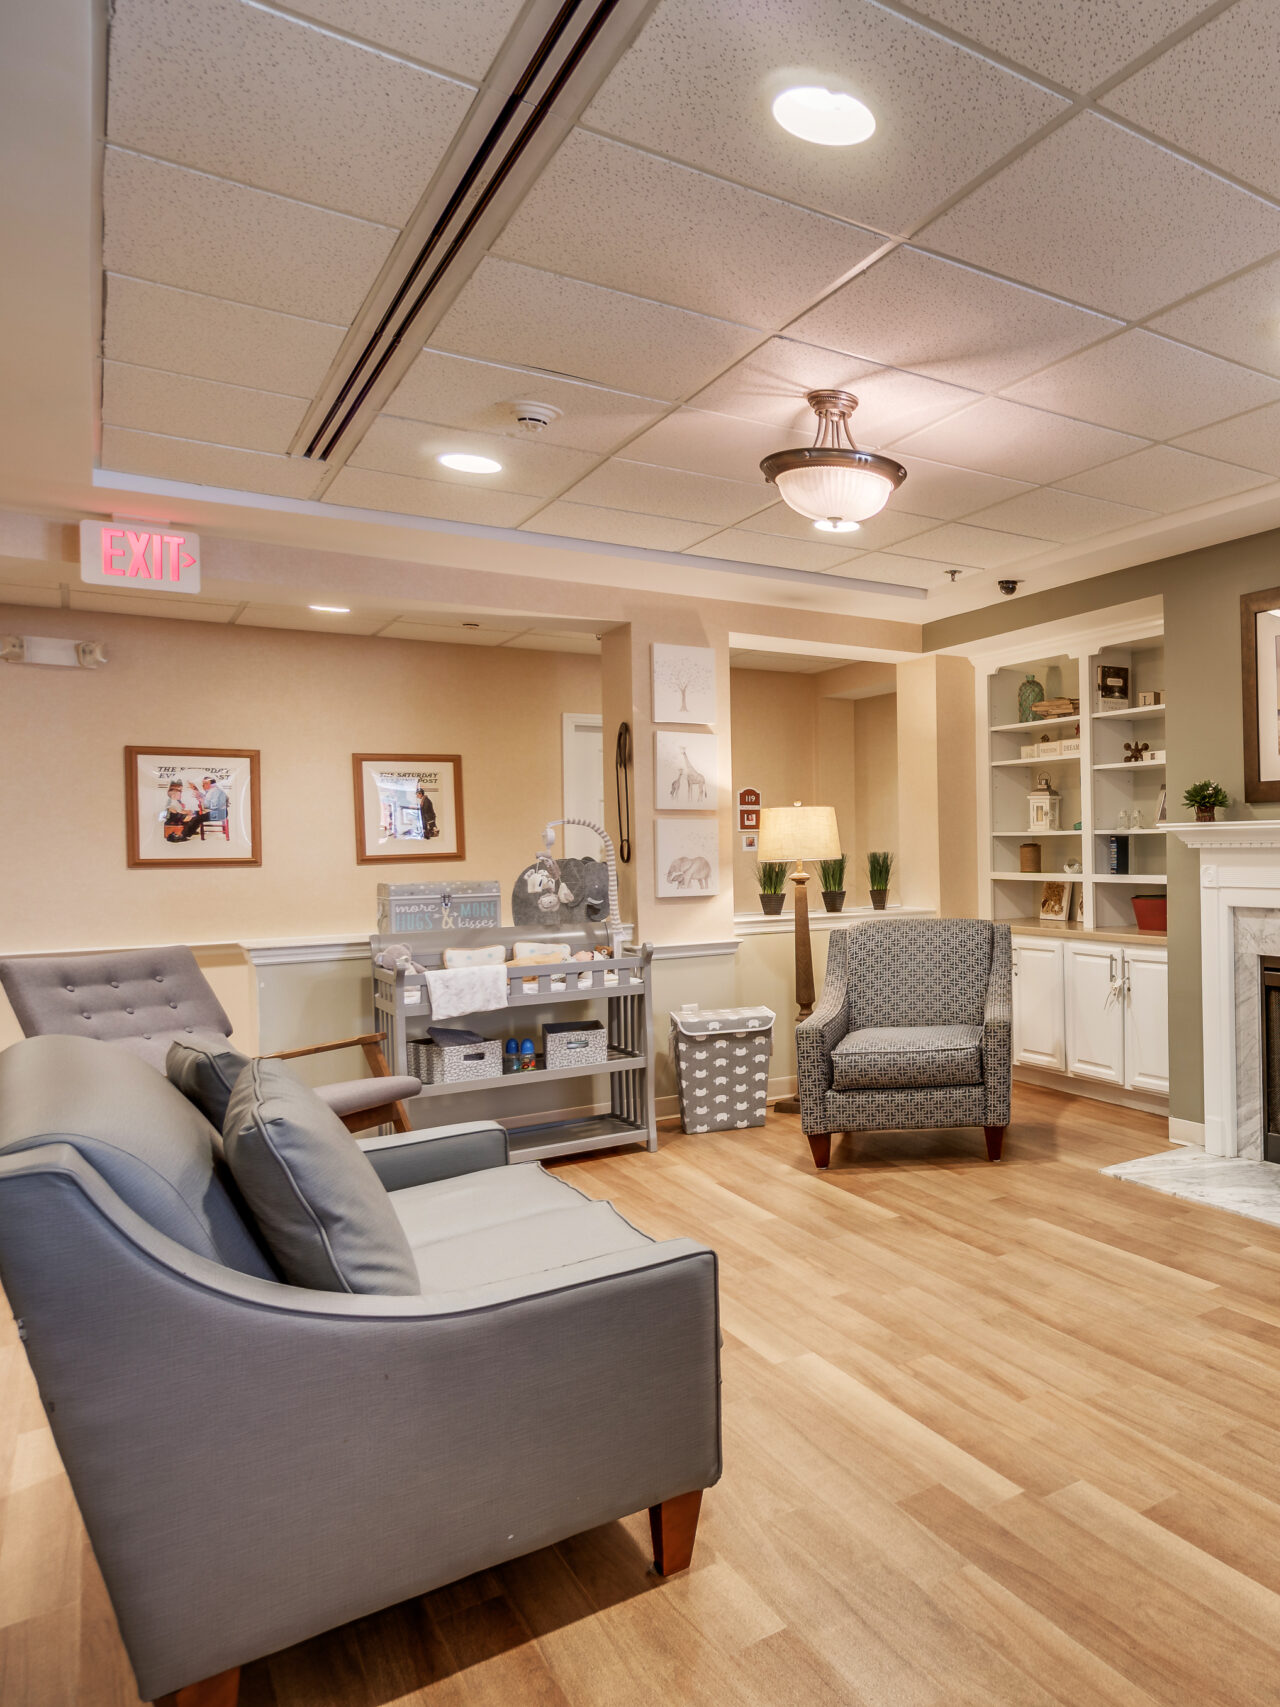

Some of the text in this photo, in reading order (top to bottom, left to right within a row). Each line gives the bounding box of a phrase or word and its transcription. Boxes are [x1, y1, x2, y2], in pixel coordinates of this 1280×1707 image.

[102, 527, 186, 582] EXIT
[745, 795, 756, 803] 119
[395, 904, 438, 913] more
[460, 901, 496, 917] MORE
[396, 912, 433, 931] HUGS
[458, 918, 496, 929] kisses
